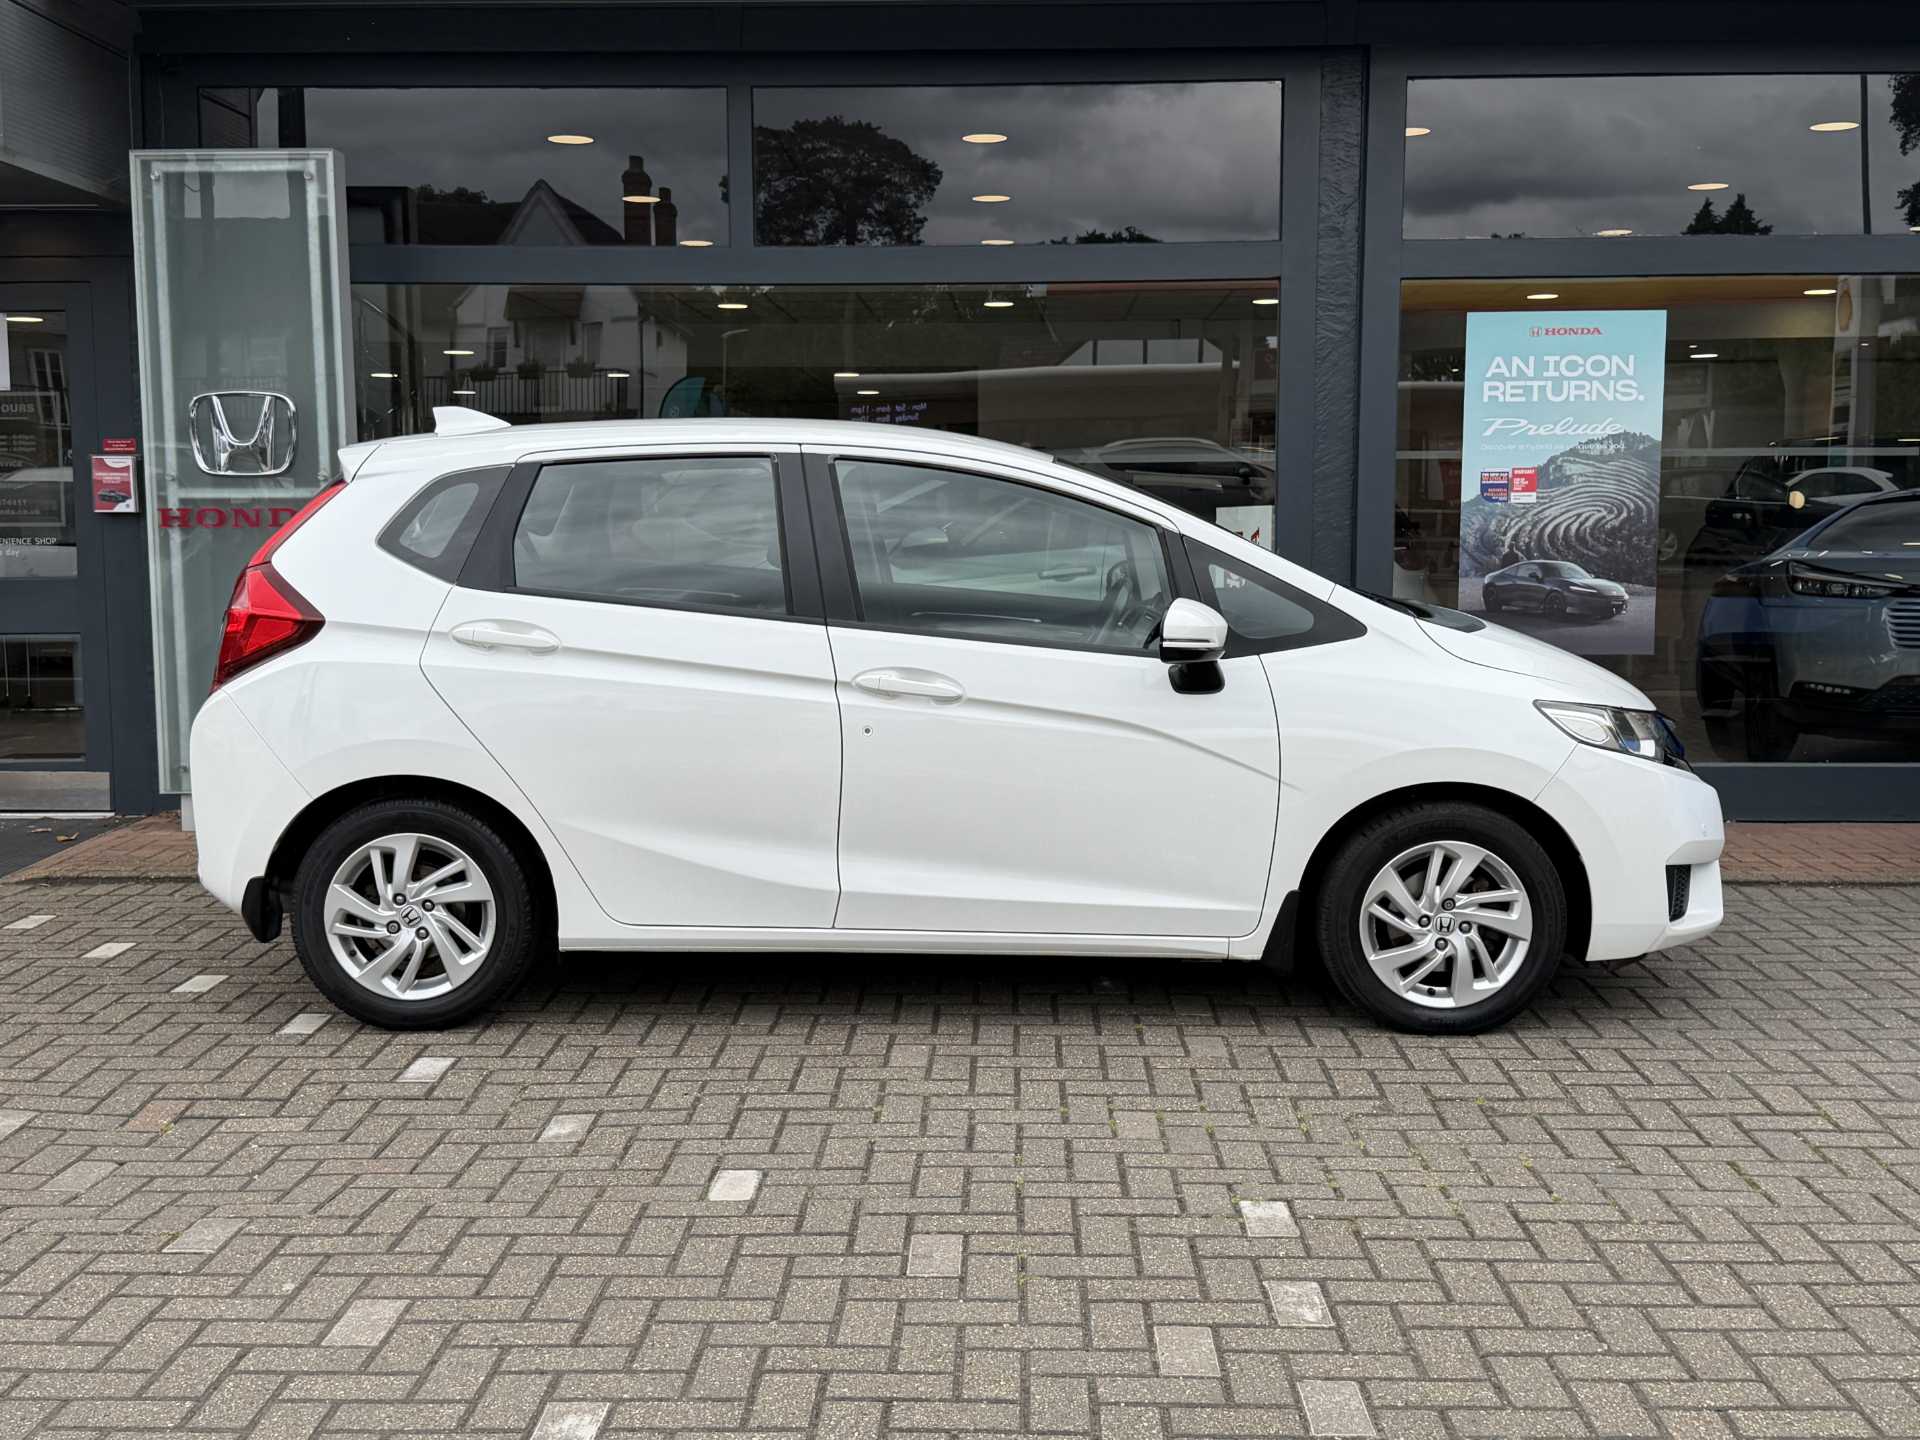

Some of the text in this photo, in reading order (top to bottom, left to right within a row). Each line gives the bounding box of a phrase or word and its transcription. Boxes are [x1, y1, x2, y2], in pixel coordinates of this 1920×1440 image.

[1544, 327, 1603, 337] HONDA
[1485, 354, 1635, 378] AN ICON
[1482, 379, 1645, 403] RETURNS.
[1481, 416, 1624, 437] Prelude
[157, 507, 297, 529] HOND
[34, 537, 57, 545] SHOP
